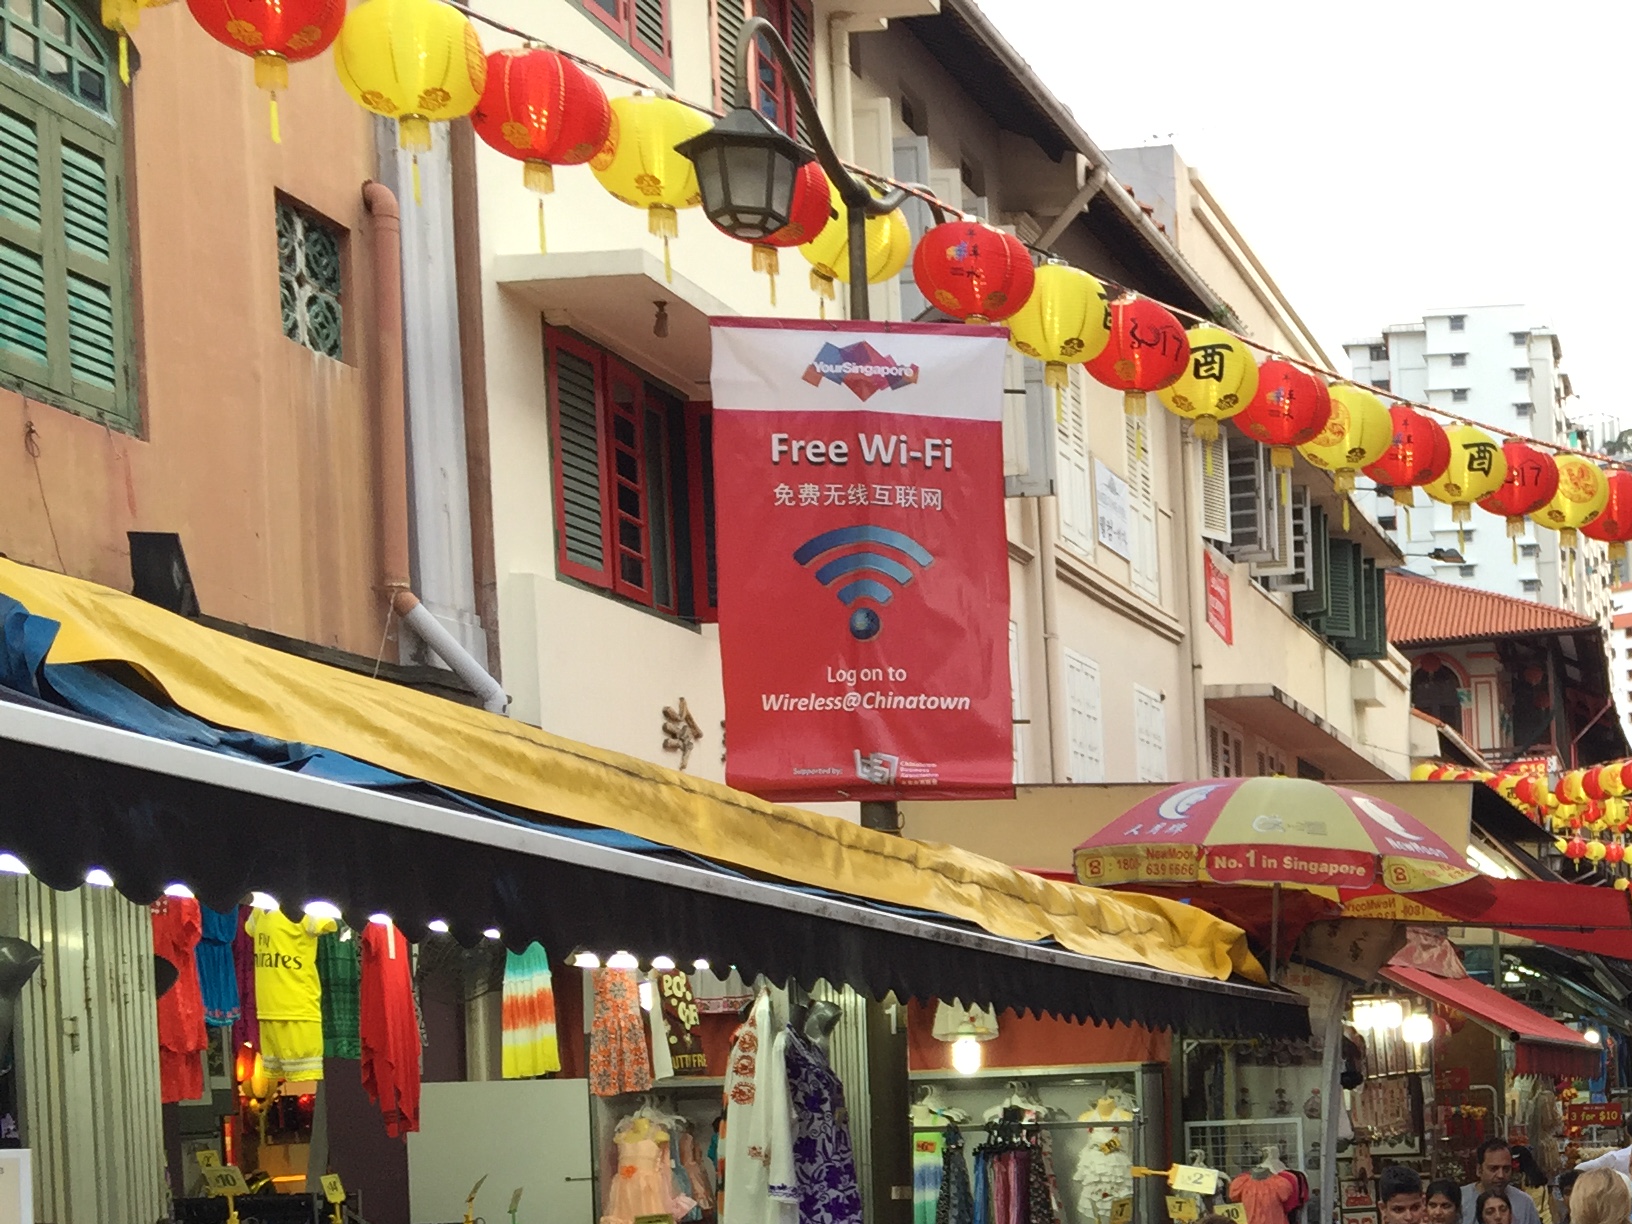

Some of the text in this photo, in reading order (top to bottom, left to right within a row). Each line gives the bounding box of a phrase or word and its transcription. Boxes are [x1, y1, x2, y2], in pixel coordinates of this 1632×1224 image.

[813, 361, 914, 377] YourSingapore
[770, 433, 953, 469] Free Wi-Fi
[773, 483, 943, 511] 免费无线互联网
[827, 666, 907, 687] Log on to
[761, 692, 971, 713] Wireless@Chinatown
[1214, 850, 1366, 876] No. 1 in Singapore
[1599, 1110, 1618, 1122] $10
